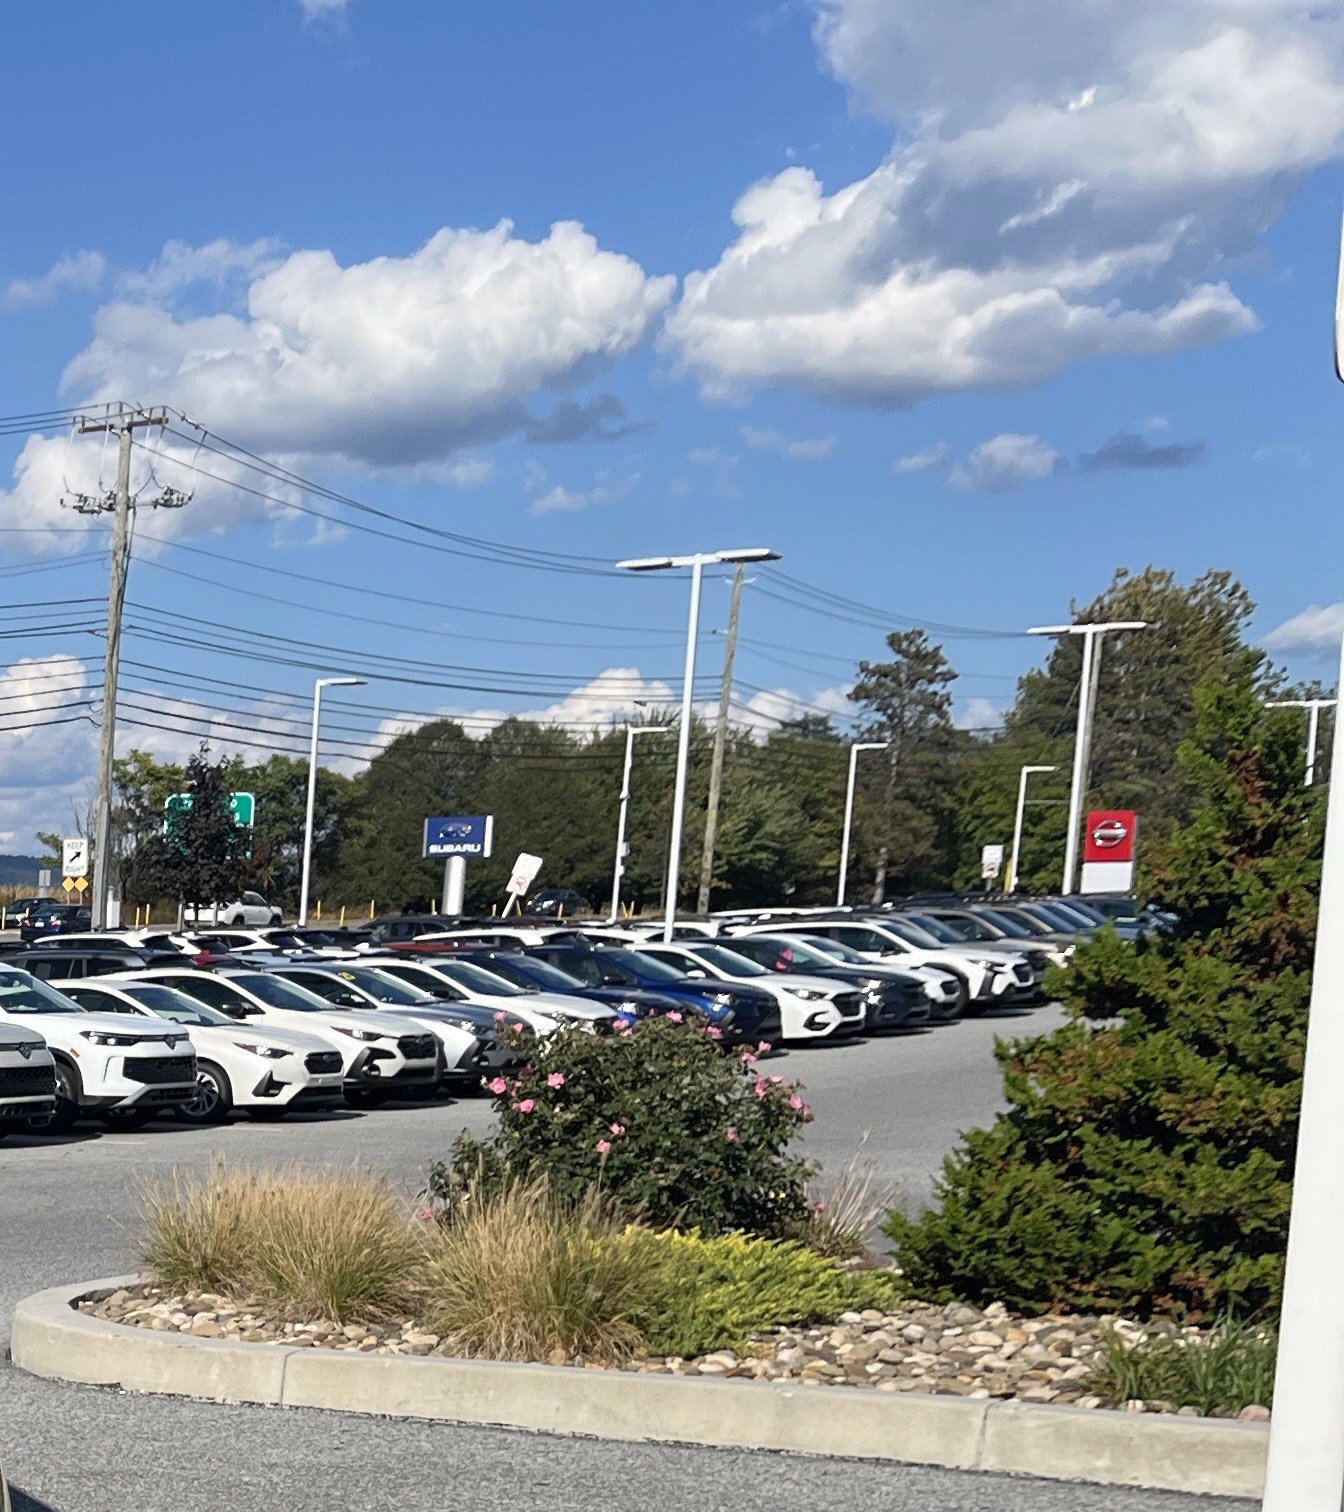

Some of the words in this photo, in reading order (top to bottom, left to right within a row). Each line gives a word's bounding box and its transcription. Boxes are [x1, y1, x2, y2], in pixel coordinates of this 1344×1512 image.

[66, 841, 84, 850] KEEP
[429, 843, 481, 853] SUBARU
[65, 864, 85, 872] RIGHT
